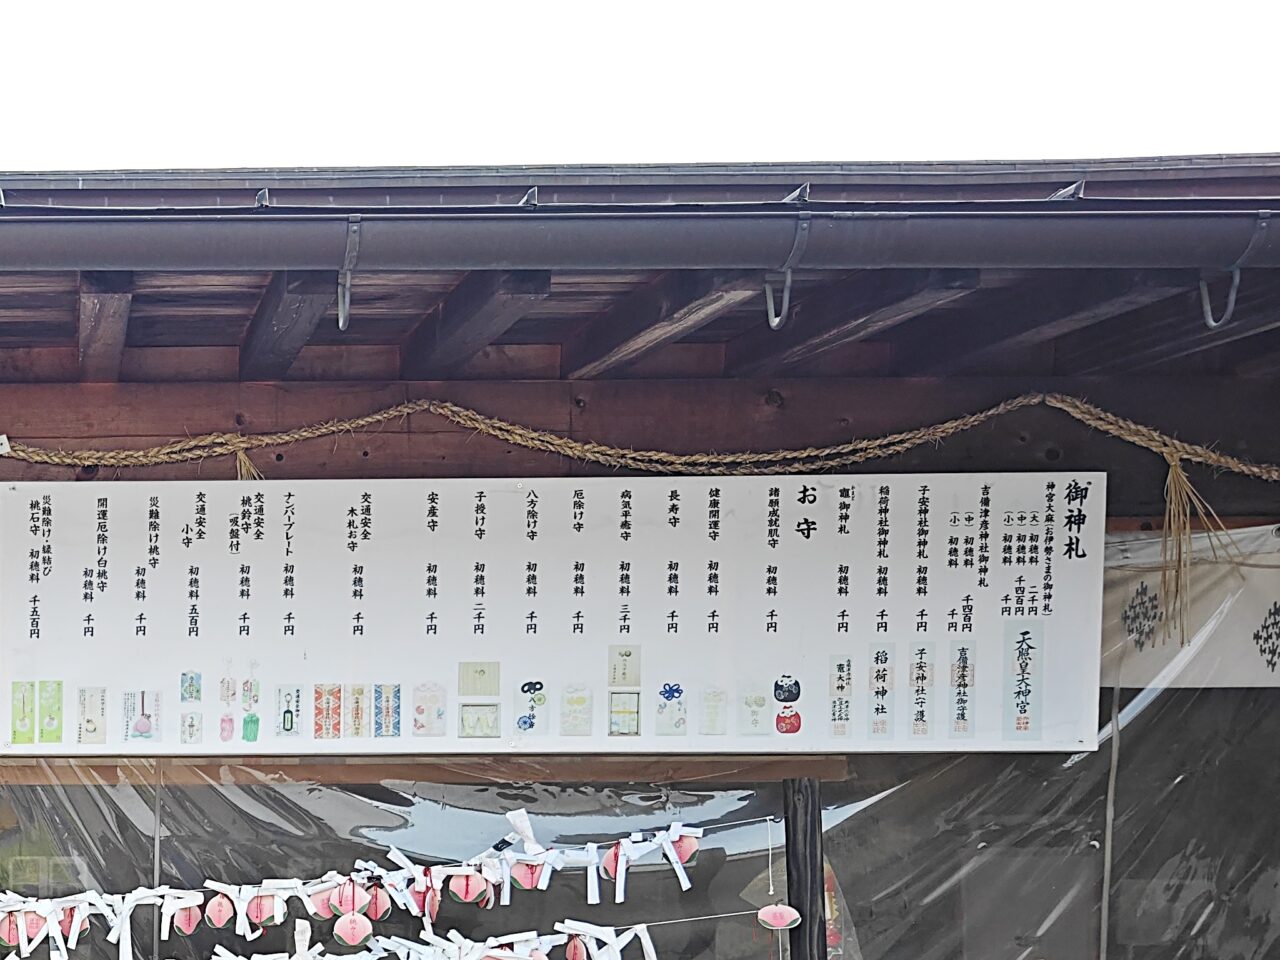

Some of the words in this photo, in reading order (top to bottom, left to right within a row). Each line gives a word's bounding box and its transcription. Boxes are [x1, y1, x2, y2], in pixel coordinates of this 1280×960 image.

[29, 500, 41, 536] 桃石守
[195, 492, 206, 539] 交通安全
[241, 496, 252, 534] 桃鈴守
[253, 492, 264, 540] 交通安全
[283, 492, 295, 556] ナンバープレート
[360, 492, 372, 540] 交通安全
[427, 492, 439, 532] 安産守
[475, 491, 486, 540] 子授け守
[526, 490, 538, 540] 八方除け守
[573, 490, 584, 532] 厄除け守
[620, 490, 632, 541] 病気平癒守
[668, 490, 680, 527] 長寿守
[708, 488, 720, 541] 健康開運守
[768, 487, 780, 548] 諸願成就肌守
[795, 485, 817, 539] お守
[877, 486, 890, 558] 稲荷神社御神札
[916, 485, 930, 559] 子安神社御神札
[1063, 479, 1090, 559] 御神札
[97, 498, 108, 592] 開運厄除け白桃守
[148, 497, 160, 568] 災難除け桃守
[182, 524, 193, 548] 小守
[347, 507, 358, 552] 木札お守
[978, 485, 991, 587] 吉備津彦神社御神札
[29, 549, 40, 583] 初穂料
[947, 536, 959, 568] 初穂料
[963, 536, 974, 568] 初穂料
[1002, 533, 1013, 566] 初穂料
[1016, 533, 1026, 566] 初穂料
[1028, 533, 1039, 565] 初穂料
[83, 568, 94, 602] 初穂料
[135, 566, 146, 601] 初穂料
[188, 566, 199, 600] 初穂料
[239, 564, 250, 599] 初穂料
[283, 563, 294, 599] 初穂料
[352, 564, 363, 600] 初穂料
[426, 563, 437, 598] 初穂料
[474, 562, 485, 597] 初穂料
[526, 562, 537, 597] 初穂料
[573, 561, 585, 597] 初穂料
[619, 561, 630, 596] 初穂料
[667, 561, 679, 596] 初穂料
[707, 560, 719, 595] 初穂料
[766, 565, 777, 596] 初穂料
[837, 564, 849, 596] 初穂料
[876, 565, 888, 597] 初穂料
[916, 565, 928, 596] 初穂料
[962, 594, 973, 632] 千四百円
[1001, 594, 1012, 616] 千円
[1015, 575, 1028, 616] 千四百円
[1027, 586, 1038, 615] 二千円
[29, 595, 40, 638] 千五百円
[83, 614, 94, 637] 千円
[136, 613, 146, 636] 千円
[188, 604, 199, 637] 五百円
[239, 612, 250, 636] 千円
[283, 612, 294, 635] 千円
[352, 612, 364, 635] 千円
[426, 612, 437, 634] 千円
[473, 603, 485, 634] 二千円
[526, 611, 537, 634] 千円
[572, 611, 584, 634] 千円
[619, 605, 630, 633] 三千円
[667, 610, 678, 633] 千円
[707, 610, 719, 633] 千円
[766, 609, 778, 632] 千円
[837, 609, 849, 632] 千円
[876, 609, 888, 632] 千円
[916, 609, 928, 632] 千円
[947, 609, 958, 632] 千円
[874, 650, 888, 715] 稲荷神社
[913, 648, 927, 722] 子安神社守護
[1014, 631, 1036, 714] 天照皇大神宮
